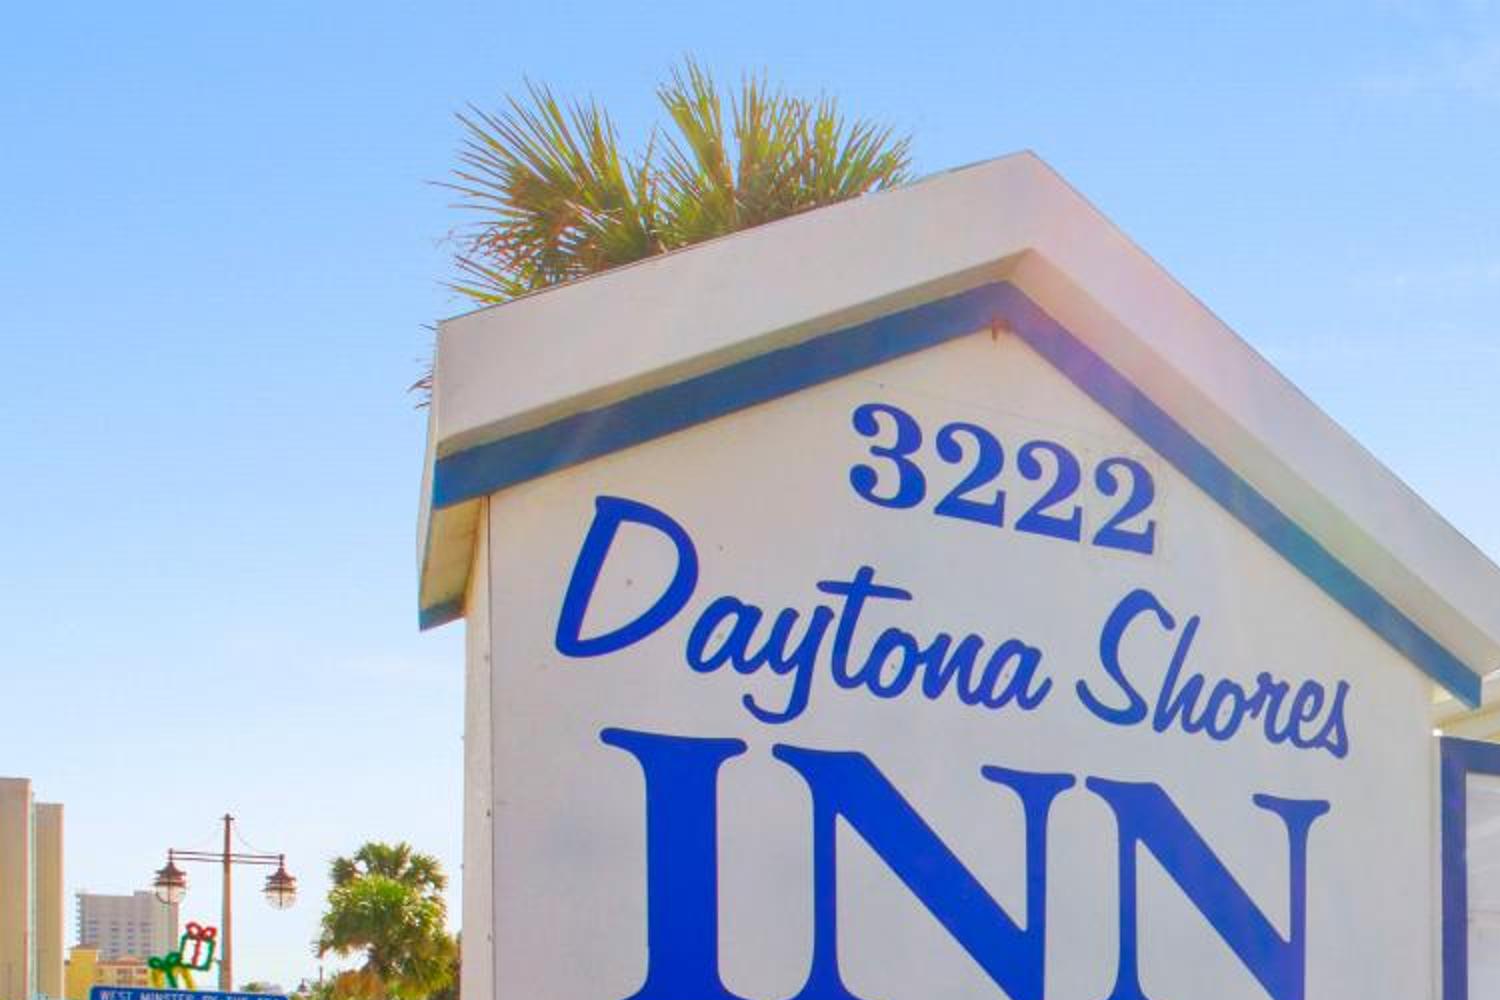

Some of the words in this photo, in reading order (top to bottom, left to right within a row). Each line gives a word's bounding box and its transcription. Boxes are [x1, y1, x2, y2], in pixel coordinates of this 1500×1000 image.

[849, 402, 1157, 555] 3222
[555, 496, 1052, 723] Daytona
[1076, 589, 1349, 759] Shores
